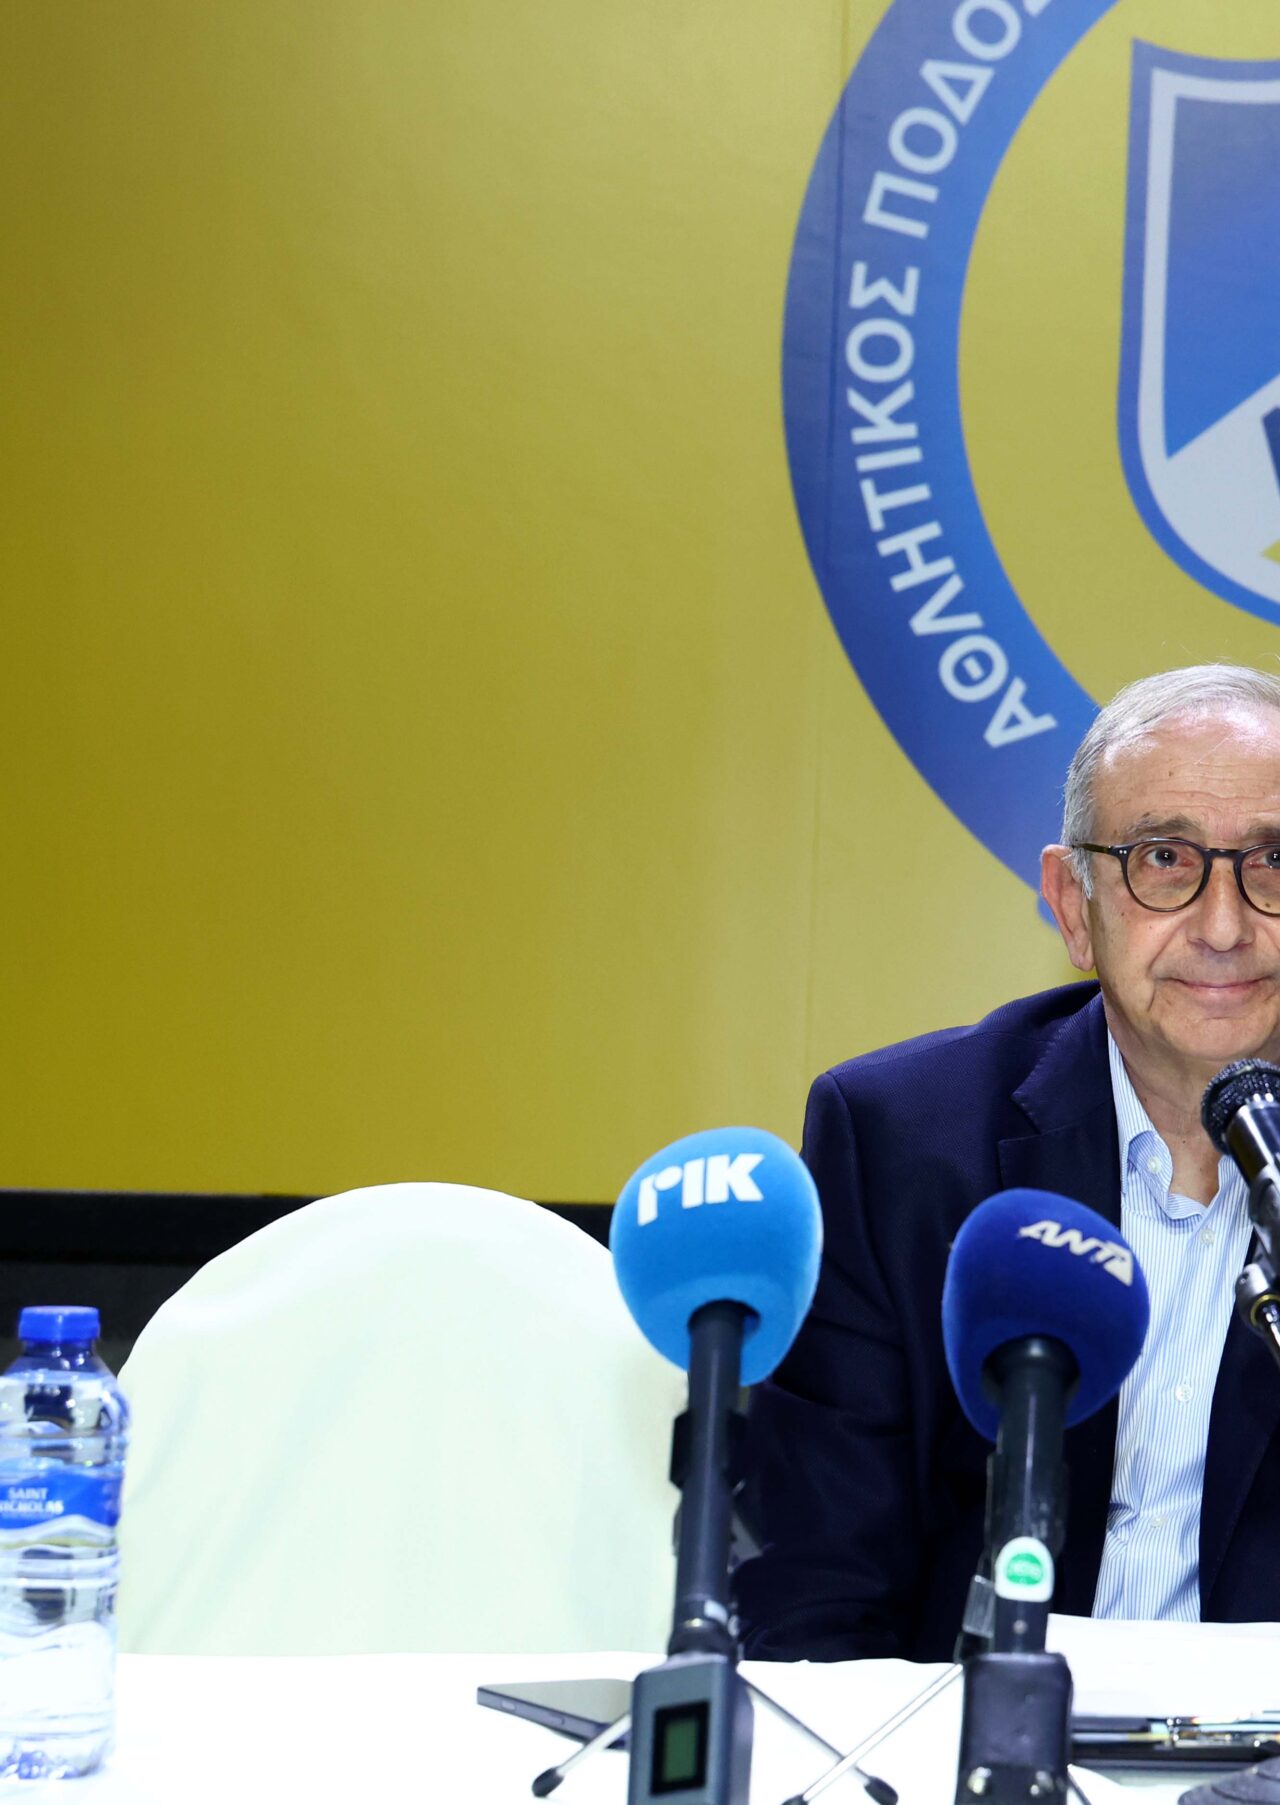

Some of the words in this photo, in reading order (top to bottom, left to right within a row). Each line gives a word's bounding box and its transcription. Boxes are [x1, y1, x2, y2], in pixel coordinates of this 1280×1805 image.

[862, 0, 1052, 239] ΠΟΔΟ
[845, 260, 1059, 749] ΑΘΛΗΤΙΚΟΣ
[0, 1500, 64, 1514] ICHOLAS
[8, 1487, 48, 1500] SAINT
